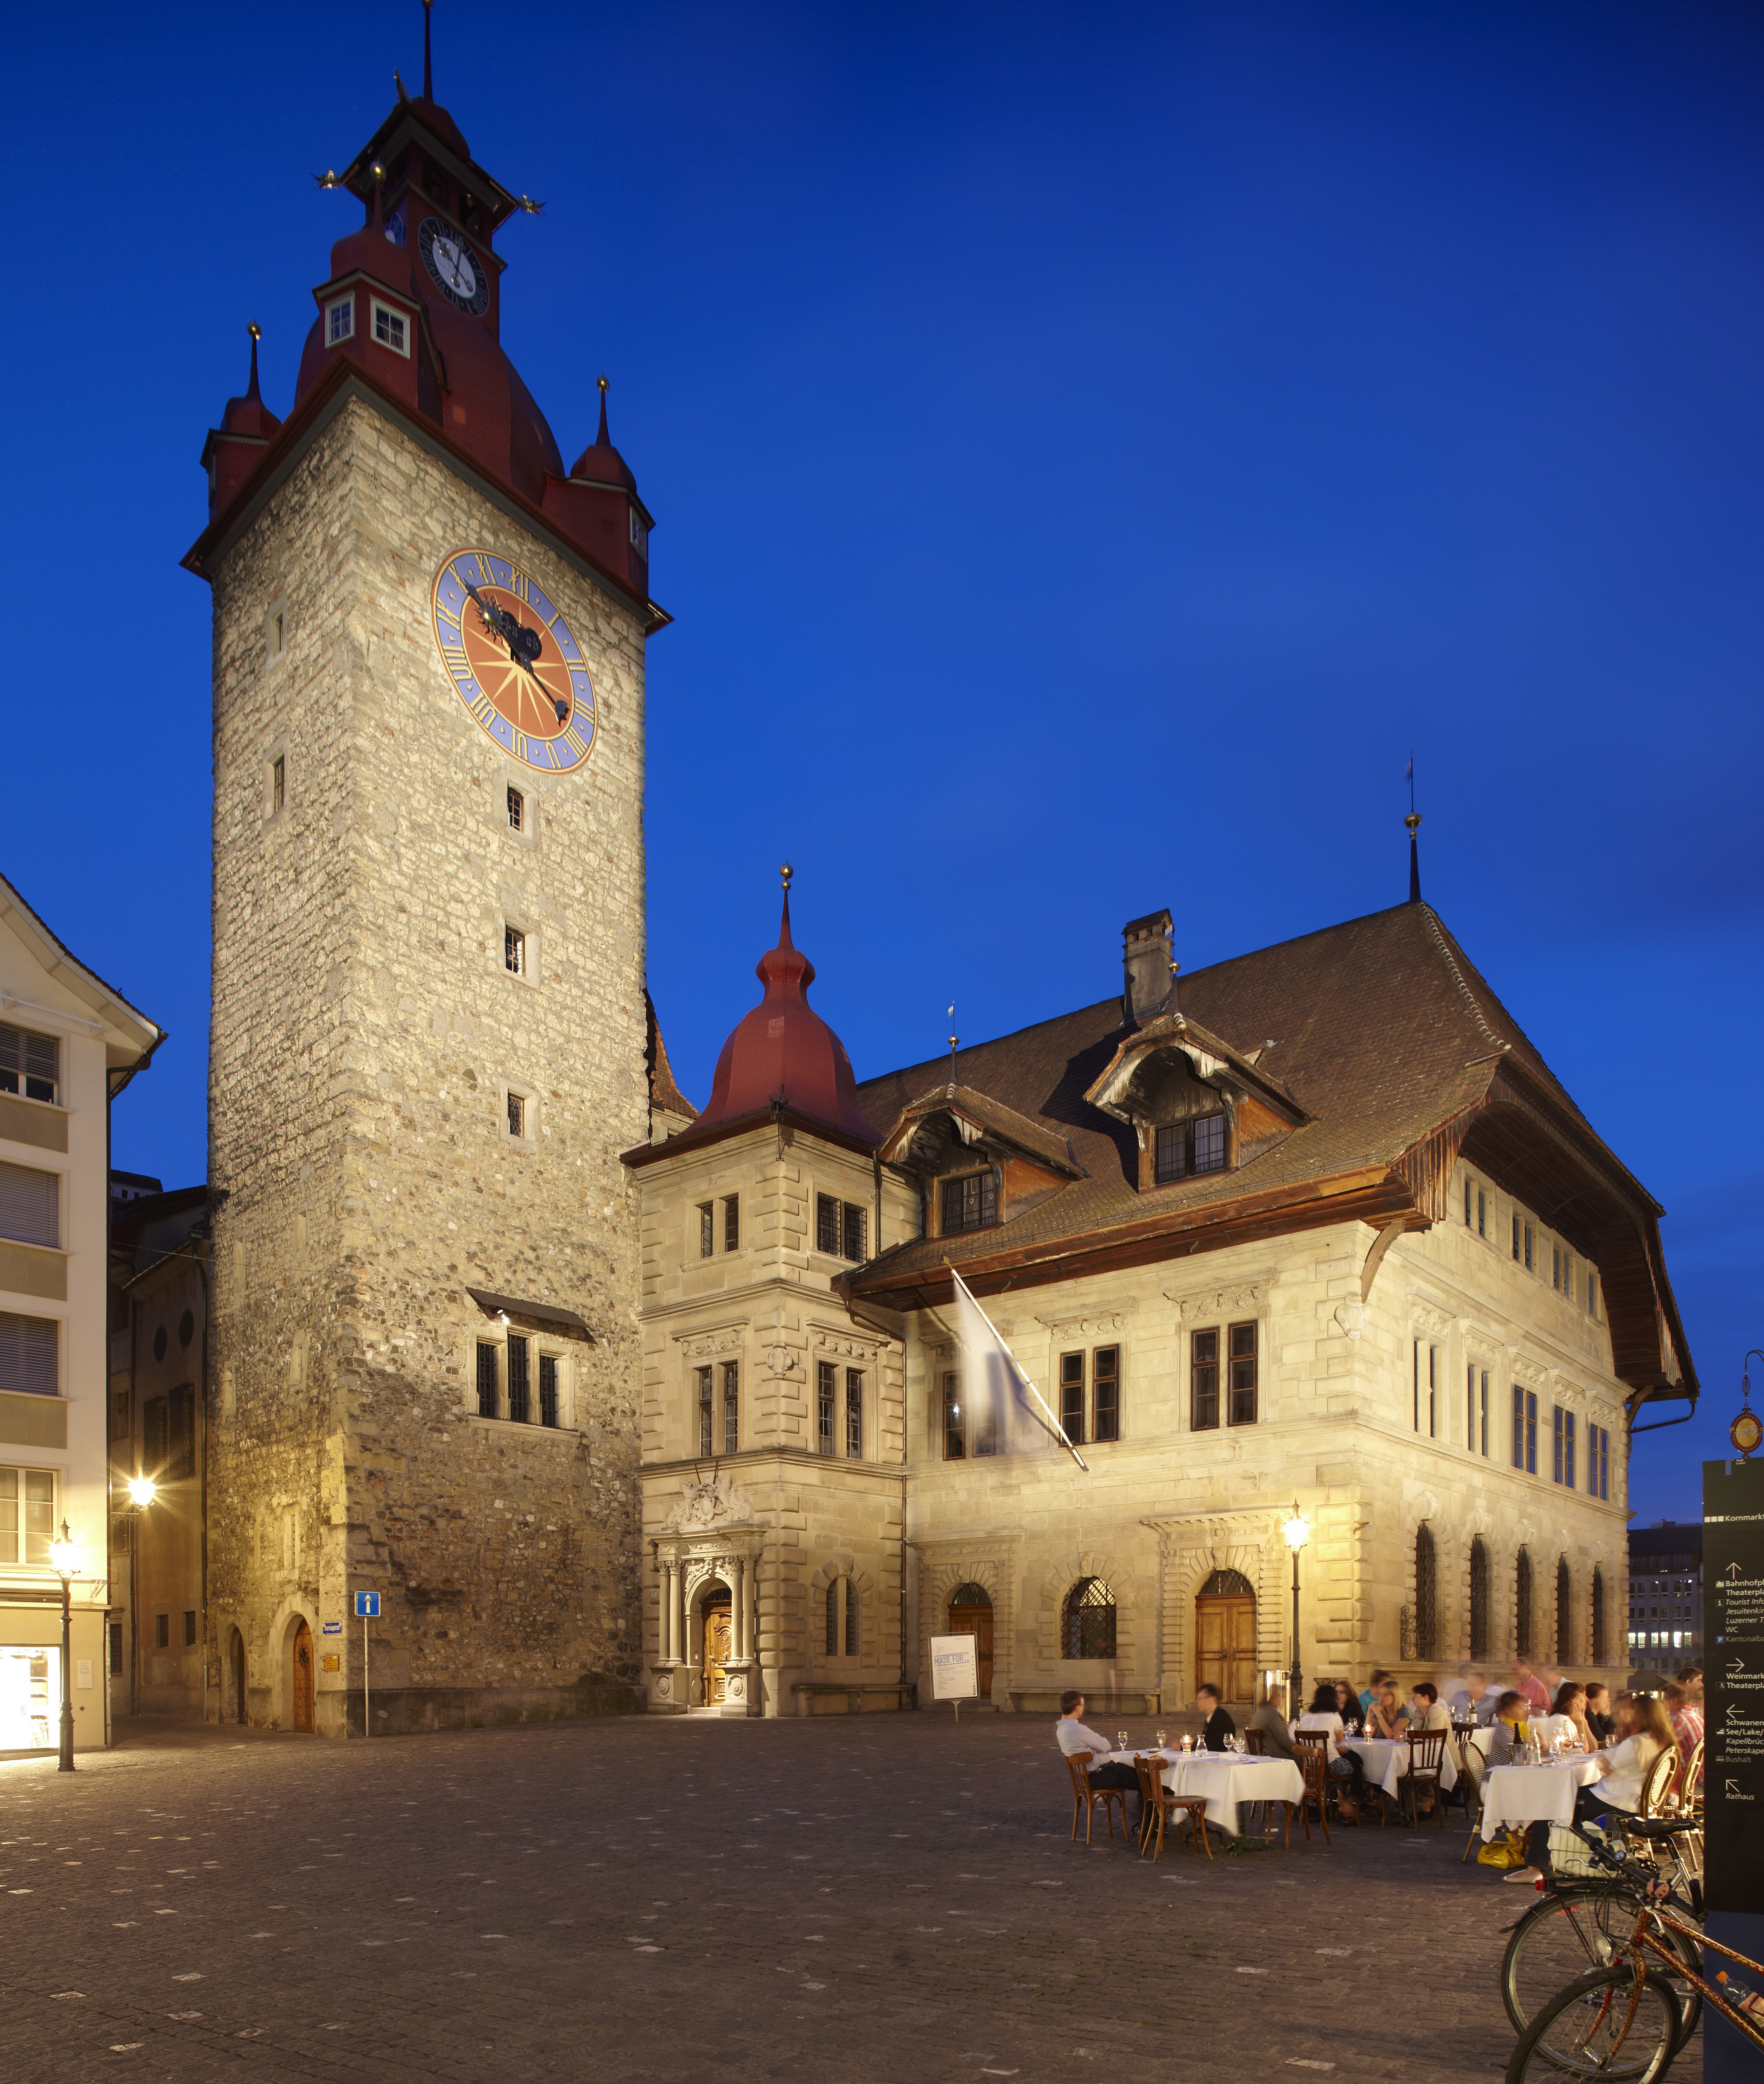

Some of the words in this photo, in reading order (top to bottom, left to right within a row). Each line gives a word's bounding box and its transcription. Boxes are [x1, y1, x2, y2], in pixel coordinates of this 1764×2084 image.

[475, 553, 497, 585] XI
[509, 566, 530, 602] XII
[436, 597, 461, 631] IX
[547, 612, 560, 629] I
[443, 645, 473, 681] VIII
[566, 658, 587, 673] II
[574, 696, 595, 725] III
[563, 725, 589, 759] IIII
[934, 1656, 951, 1665] MADE
[952, 1655, 964, 1663] FOR
[1726, 1728, 1764, 1737] See/Lake/
